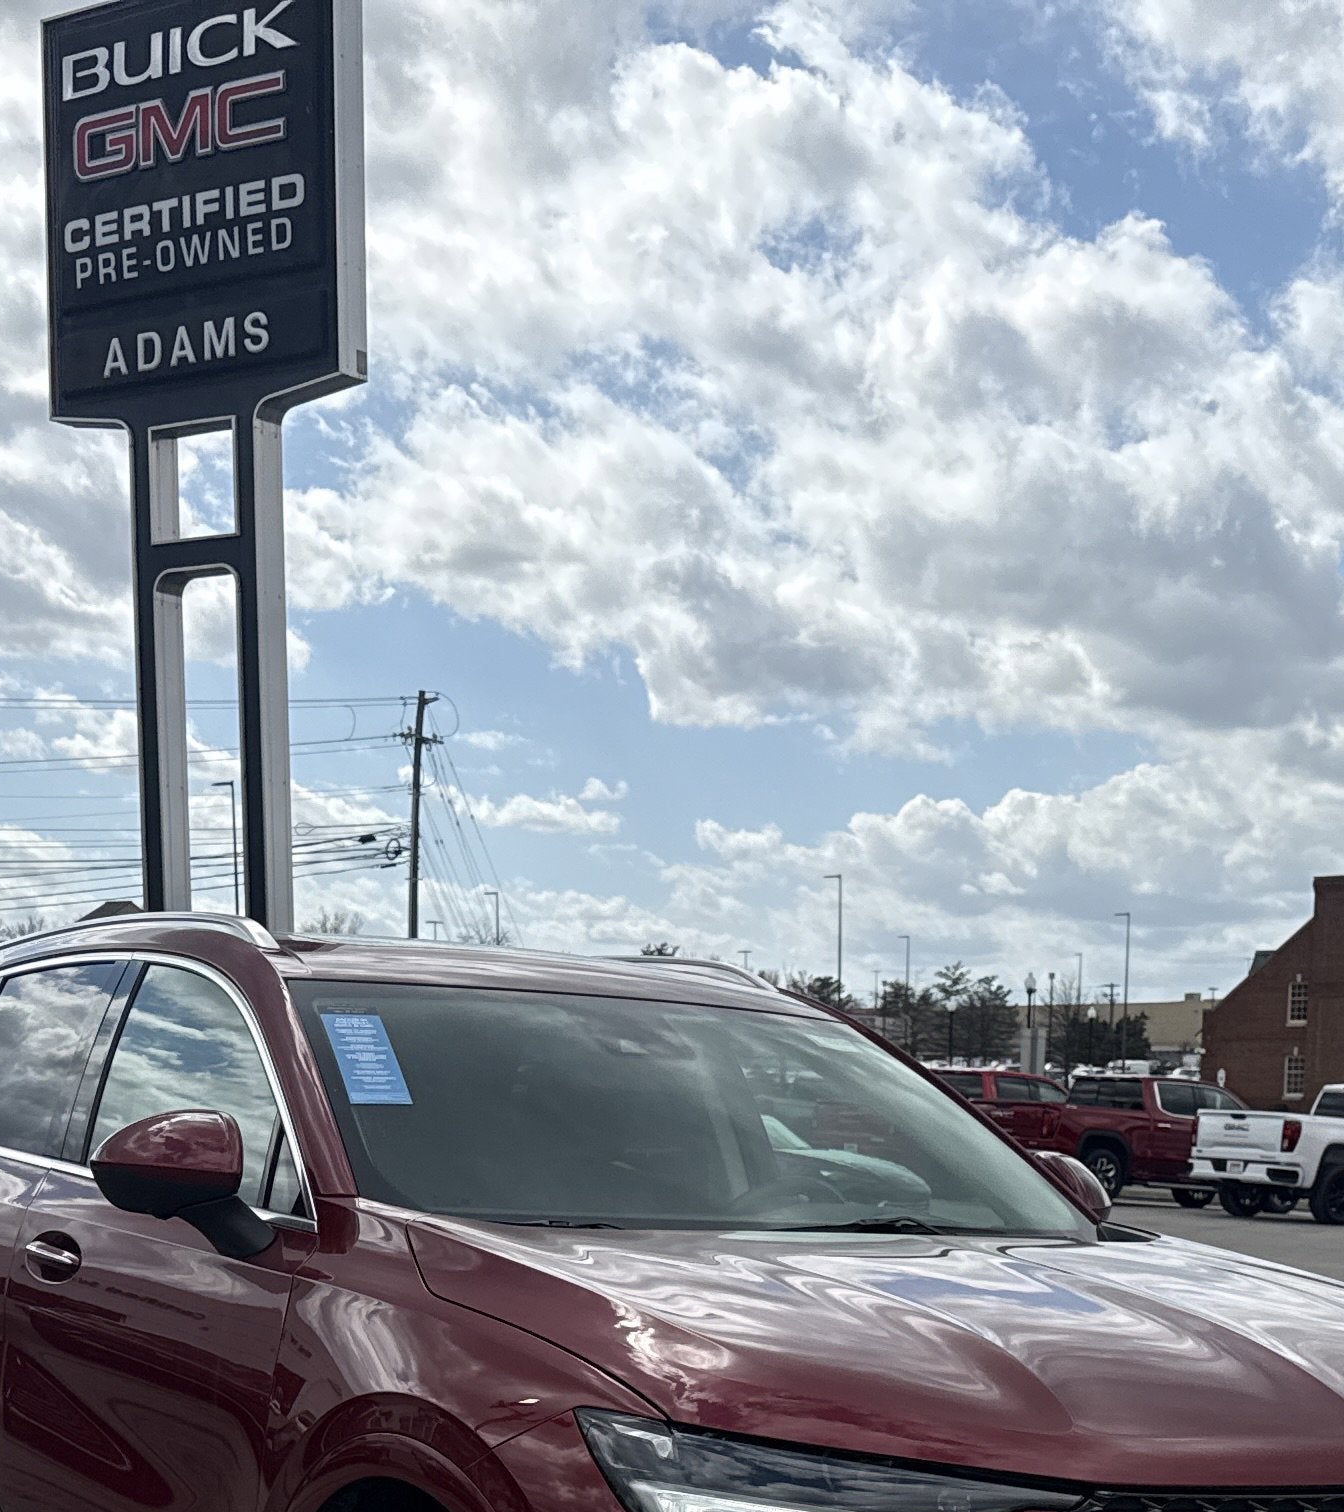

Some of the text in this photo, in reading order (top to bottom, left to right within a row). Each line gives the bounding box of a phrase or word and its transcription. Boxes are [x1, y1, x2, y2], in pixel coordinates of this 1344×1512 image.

[62, 0, 300, 101] BUICK
[73, 70, 287, 182] GMC
[64, 173, 306, 253] CERTIFIED
[75, 217, 293, 289] PRE-OWNED
[103, 311, 270, 379] ADAMS
